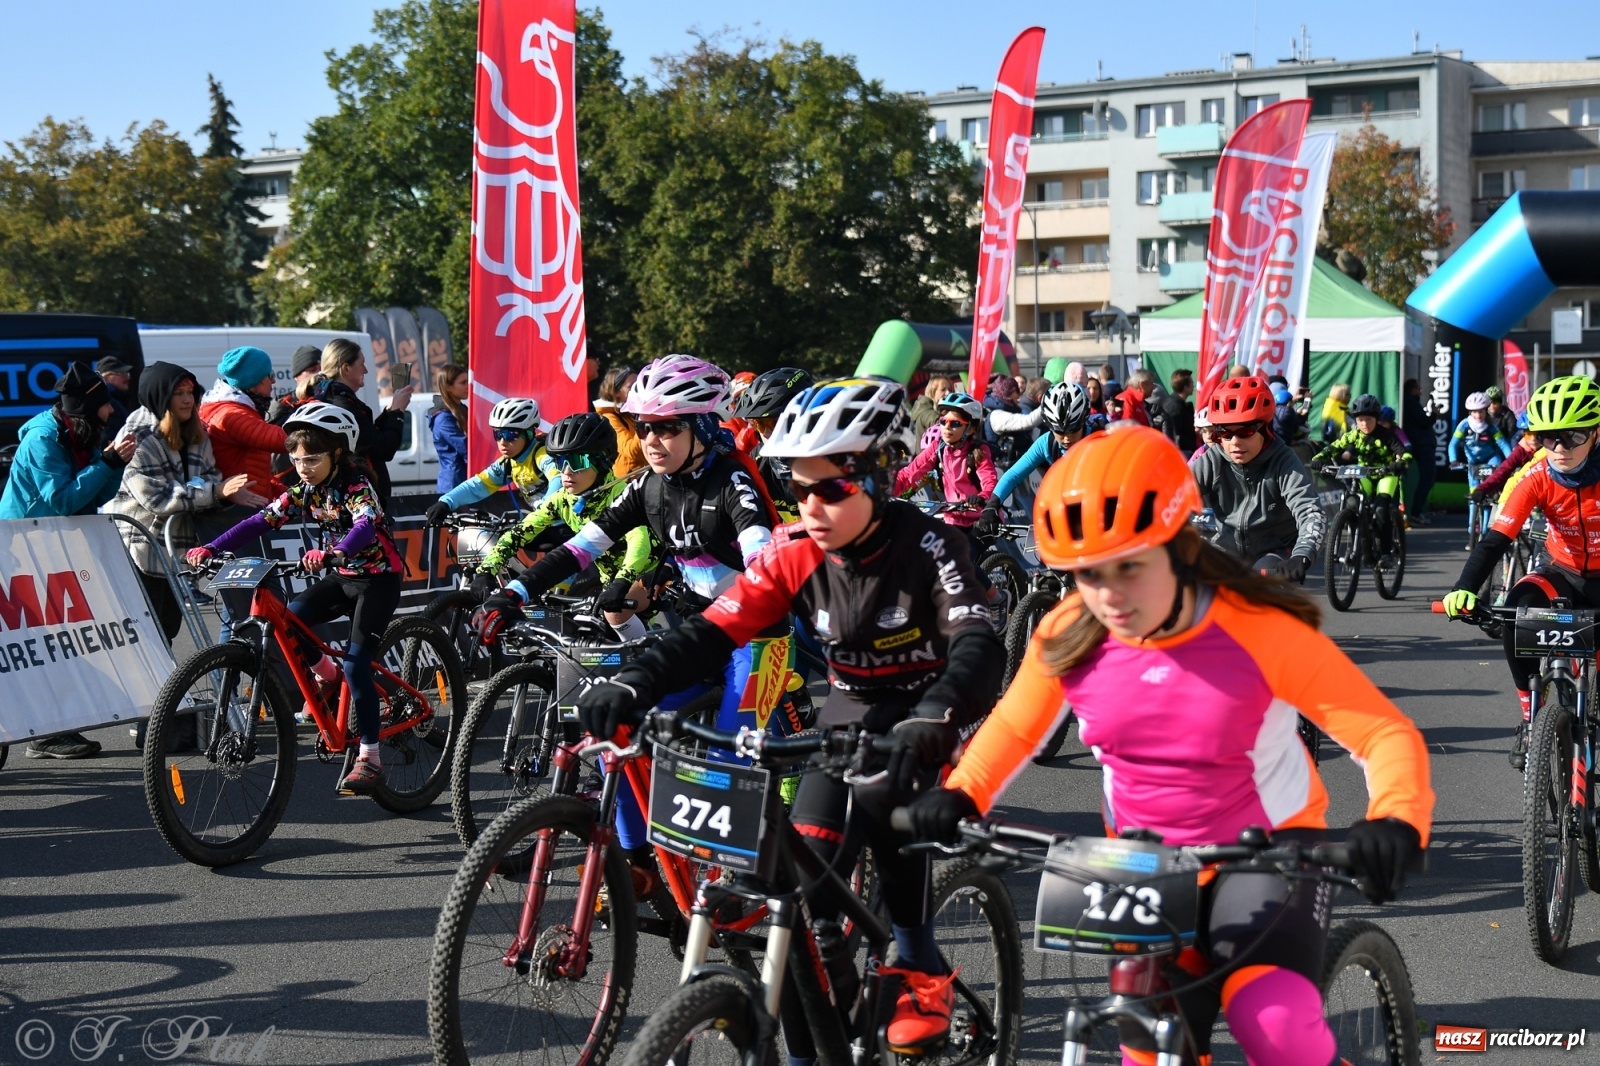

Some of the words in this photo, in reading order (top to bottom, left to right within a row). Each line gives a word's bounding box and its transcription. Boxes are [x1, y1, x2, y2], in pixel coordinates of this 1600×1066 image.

[224, 568, 254, 579] 151
[43, 617, 139, 662] FRIENDS
[1536, 629, 1574, 646] 125
[1140, 665, 1170, 684] 4F
[671, 794, 732, 837] 274
[863, 846, 872, 905] MAXXI
[1083, 881, 1162, 925] 173
